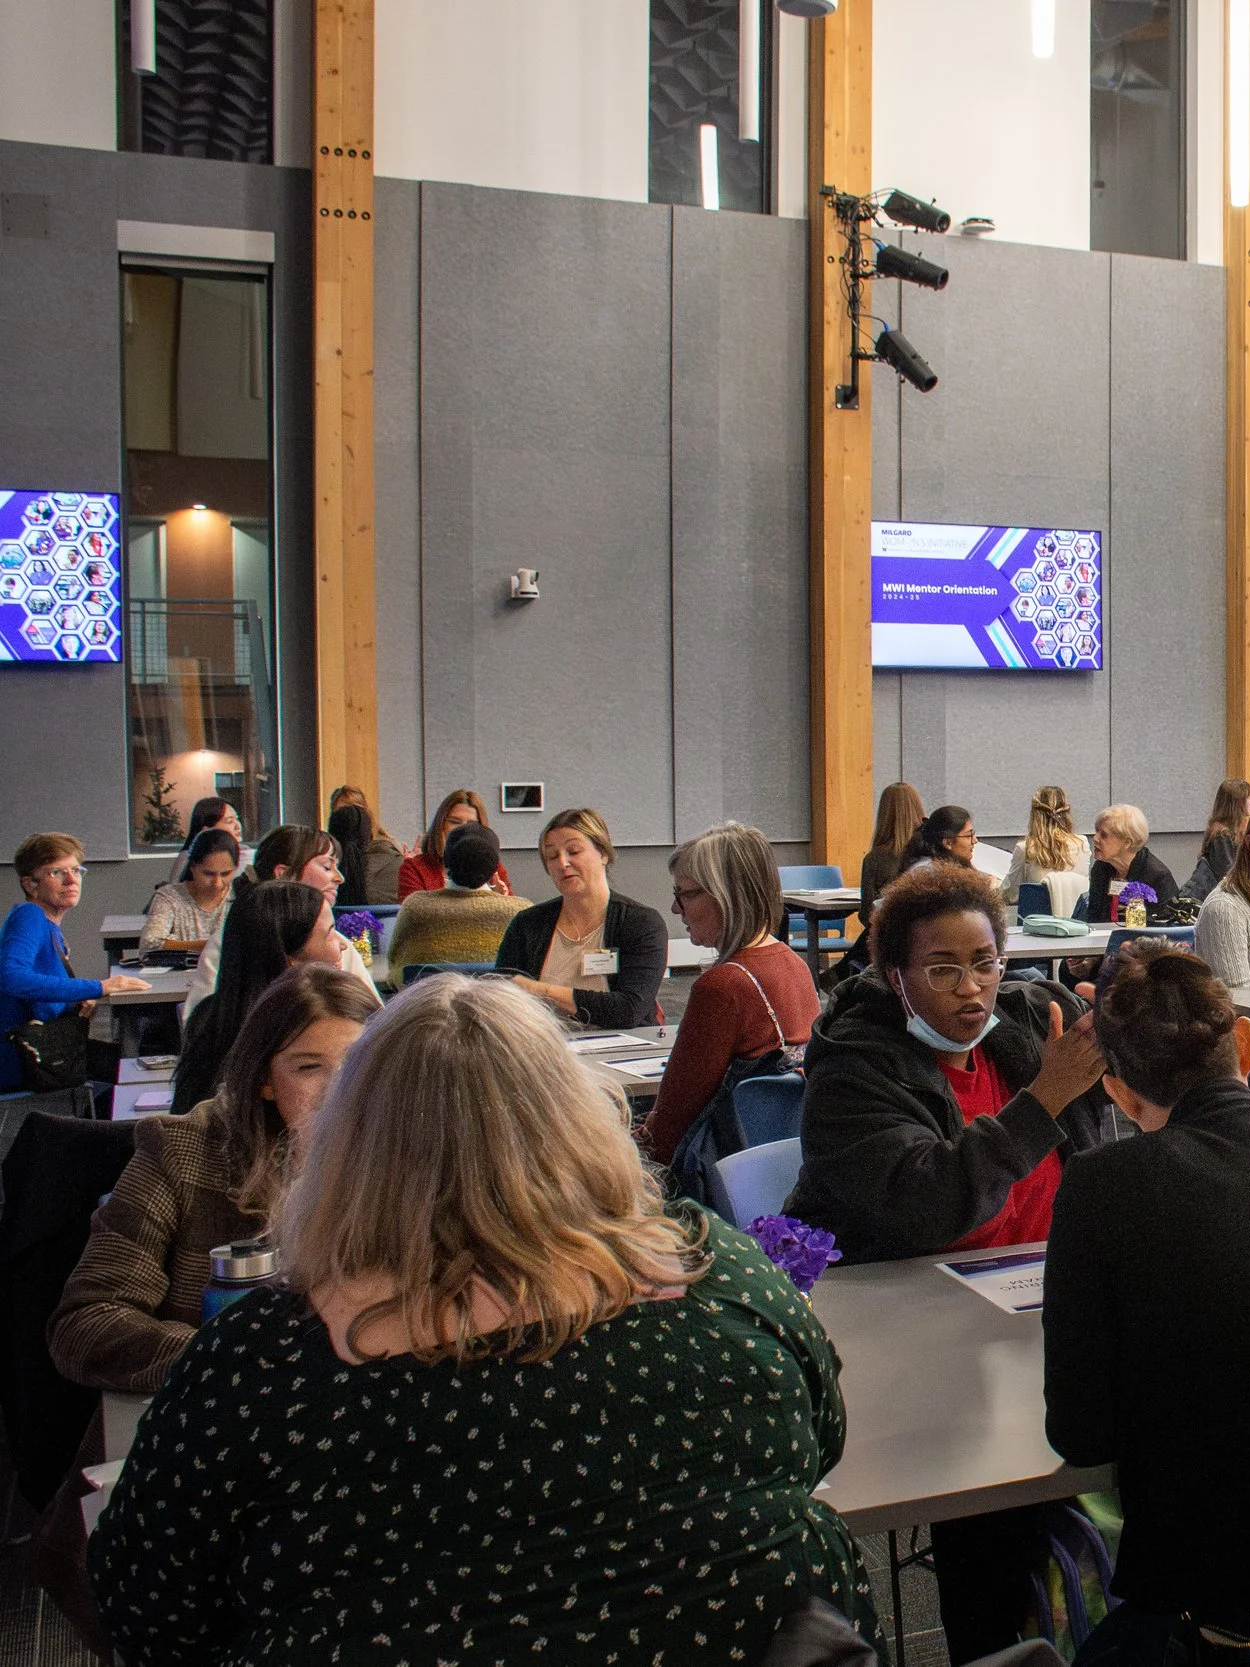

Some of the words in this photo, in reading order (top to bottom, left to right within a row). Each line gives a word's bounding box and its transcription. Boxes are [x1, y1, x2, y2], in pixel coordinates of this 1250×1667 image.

[881, 529, 912, 537] MILGARD
[882, 583, 905, 593] MWI
[906, 583, 942, 594] Mentor
[942, 584, 998, 596] Orientation
[882, 593, 920, 601] 2024-25
